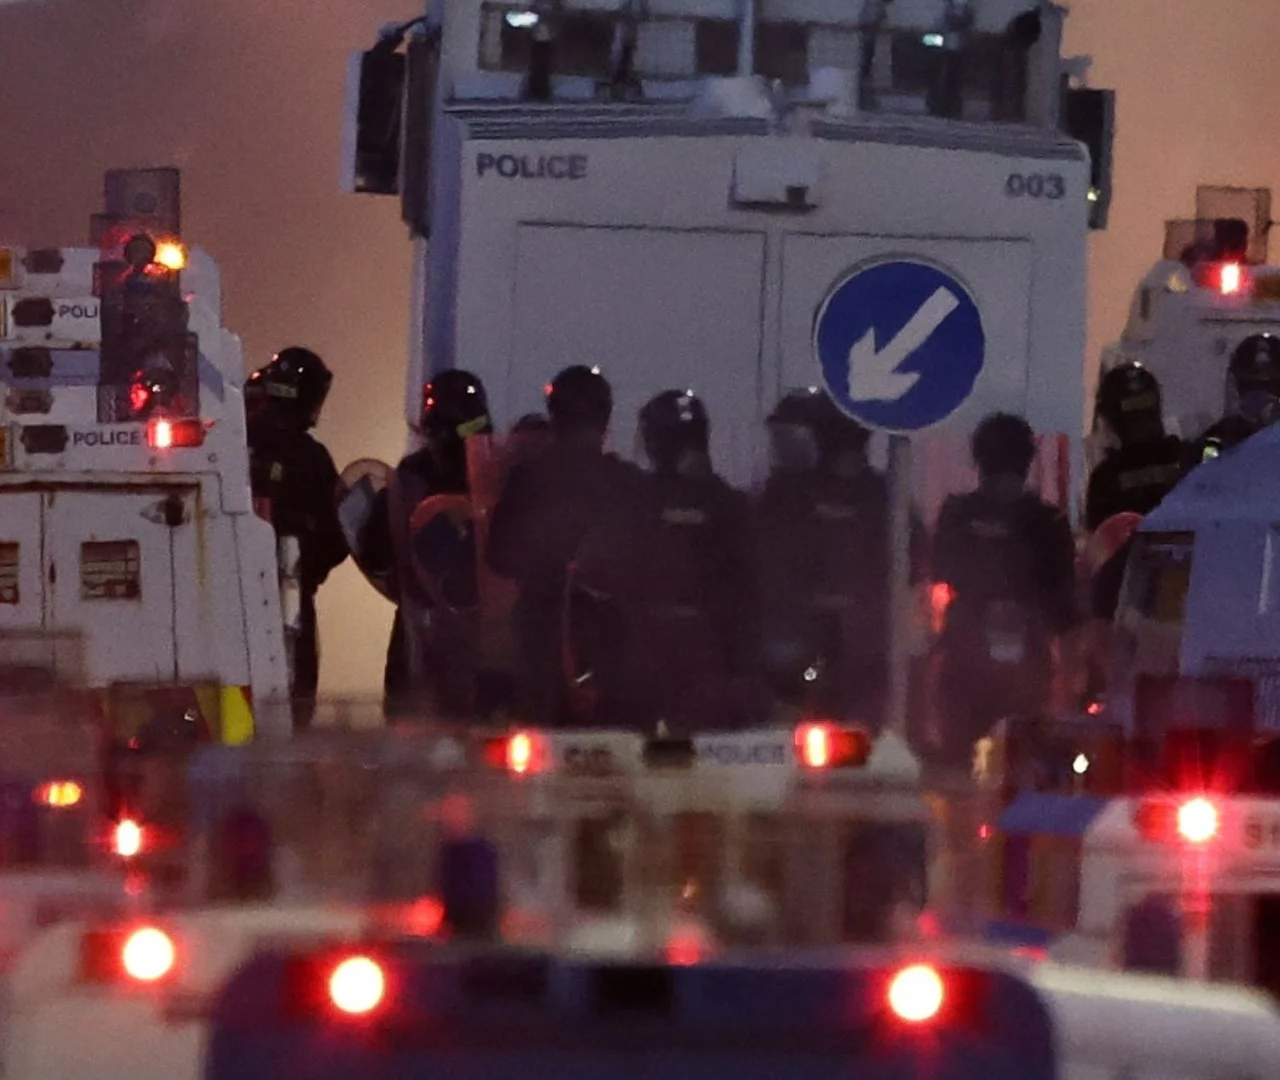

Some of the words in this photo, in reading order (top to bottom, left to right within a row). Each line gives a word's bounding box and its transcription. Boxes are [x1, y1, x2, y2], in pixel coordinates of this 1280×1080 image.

[476, 153, 588, 180] POLICE
[1004, 172, 1067, 200] 003
[58, 304, 99, 320] POLI
[73, 430, 141, 447] POLICE
